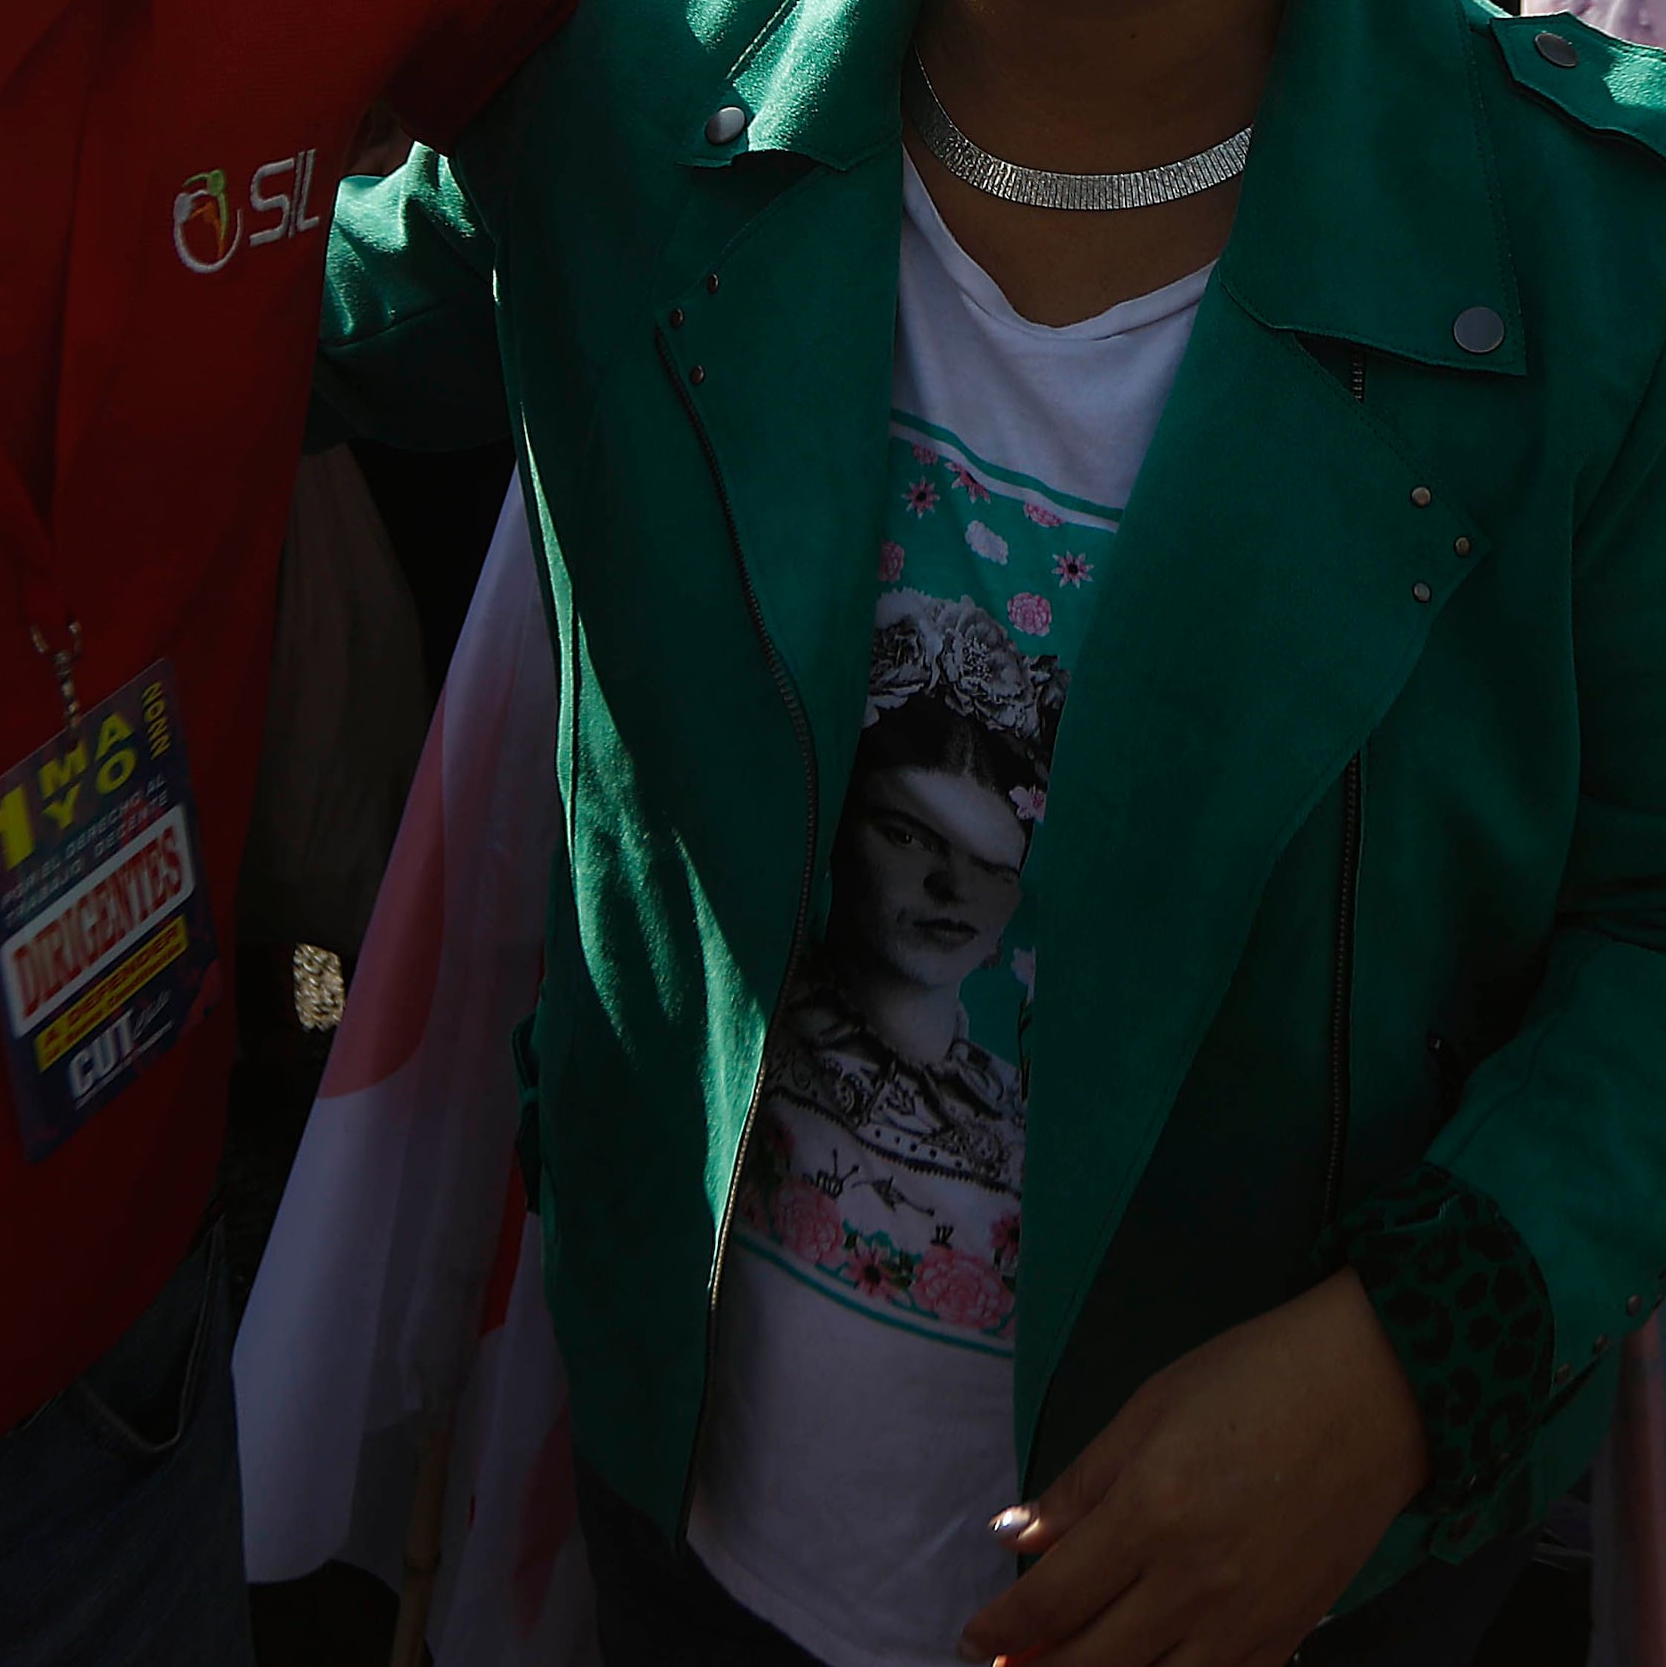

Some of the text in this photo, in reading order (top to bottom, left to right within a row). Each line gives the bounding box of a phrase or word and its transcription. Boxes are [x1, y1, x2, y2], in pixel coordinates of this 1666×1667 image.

[249, 148, 321, 248] SIL
[140, 680, 173, 762] 2022
[12, 824, 184, 1020] DIRIGENTES
[67, 1004, 136, 1103] CUT
